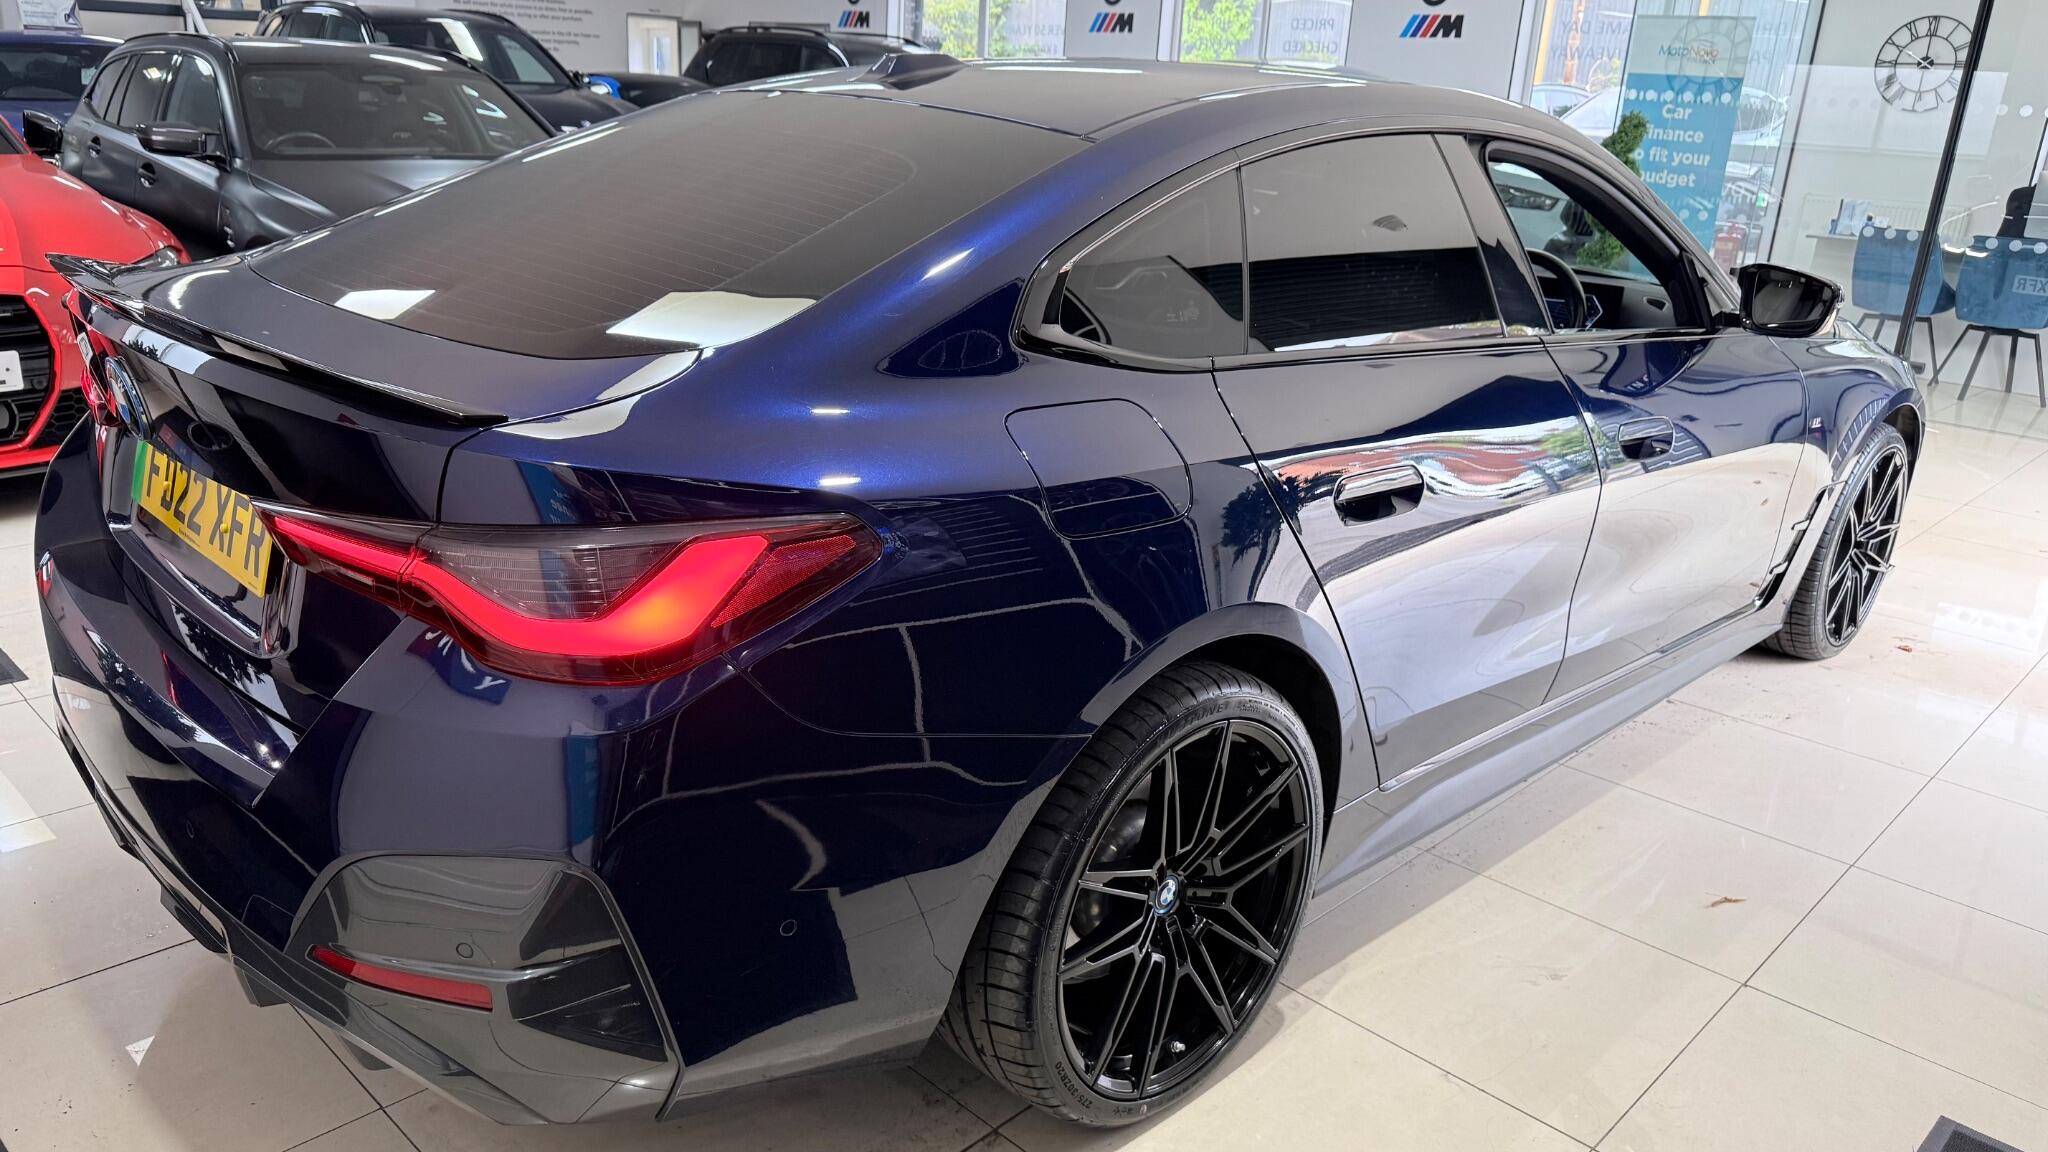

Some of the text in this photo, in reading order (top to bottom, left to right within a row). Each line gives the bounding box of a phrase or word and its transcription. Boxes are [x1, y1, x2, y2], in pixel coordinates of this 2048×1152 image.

[1658, 43, 1720, 59] MotoNovo
[1662, 103, 1693, 120] Car
[1649, 146, 1669, 164] fit
[1671, 151, 1711, 167] your
[208, 483, 266, 579] XFR
